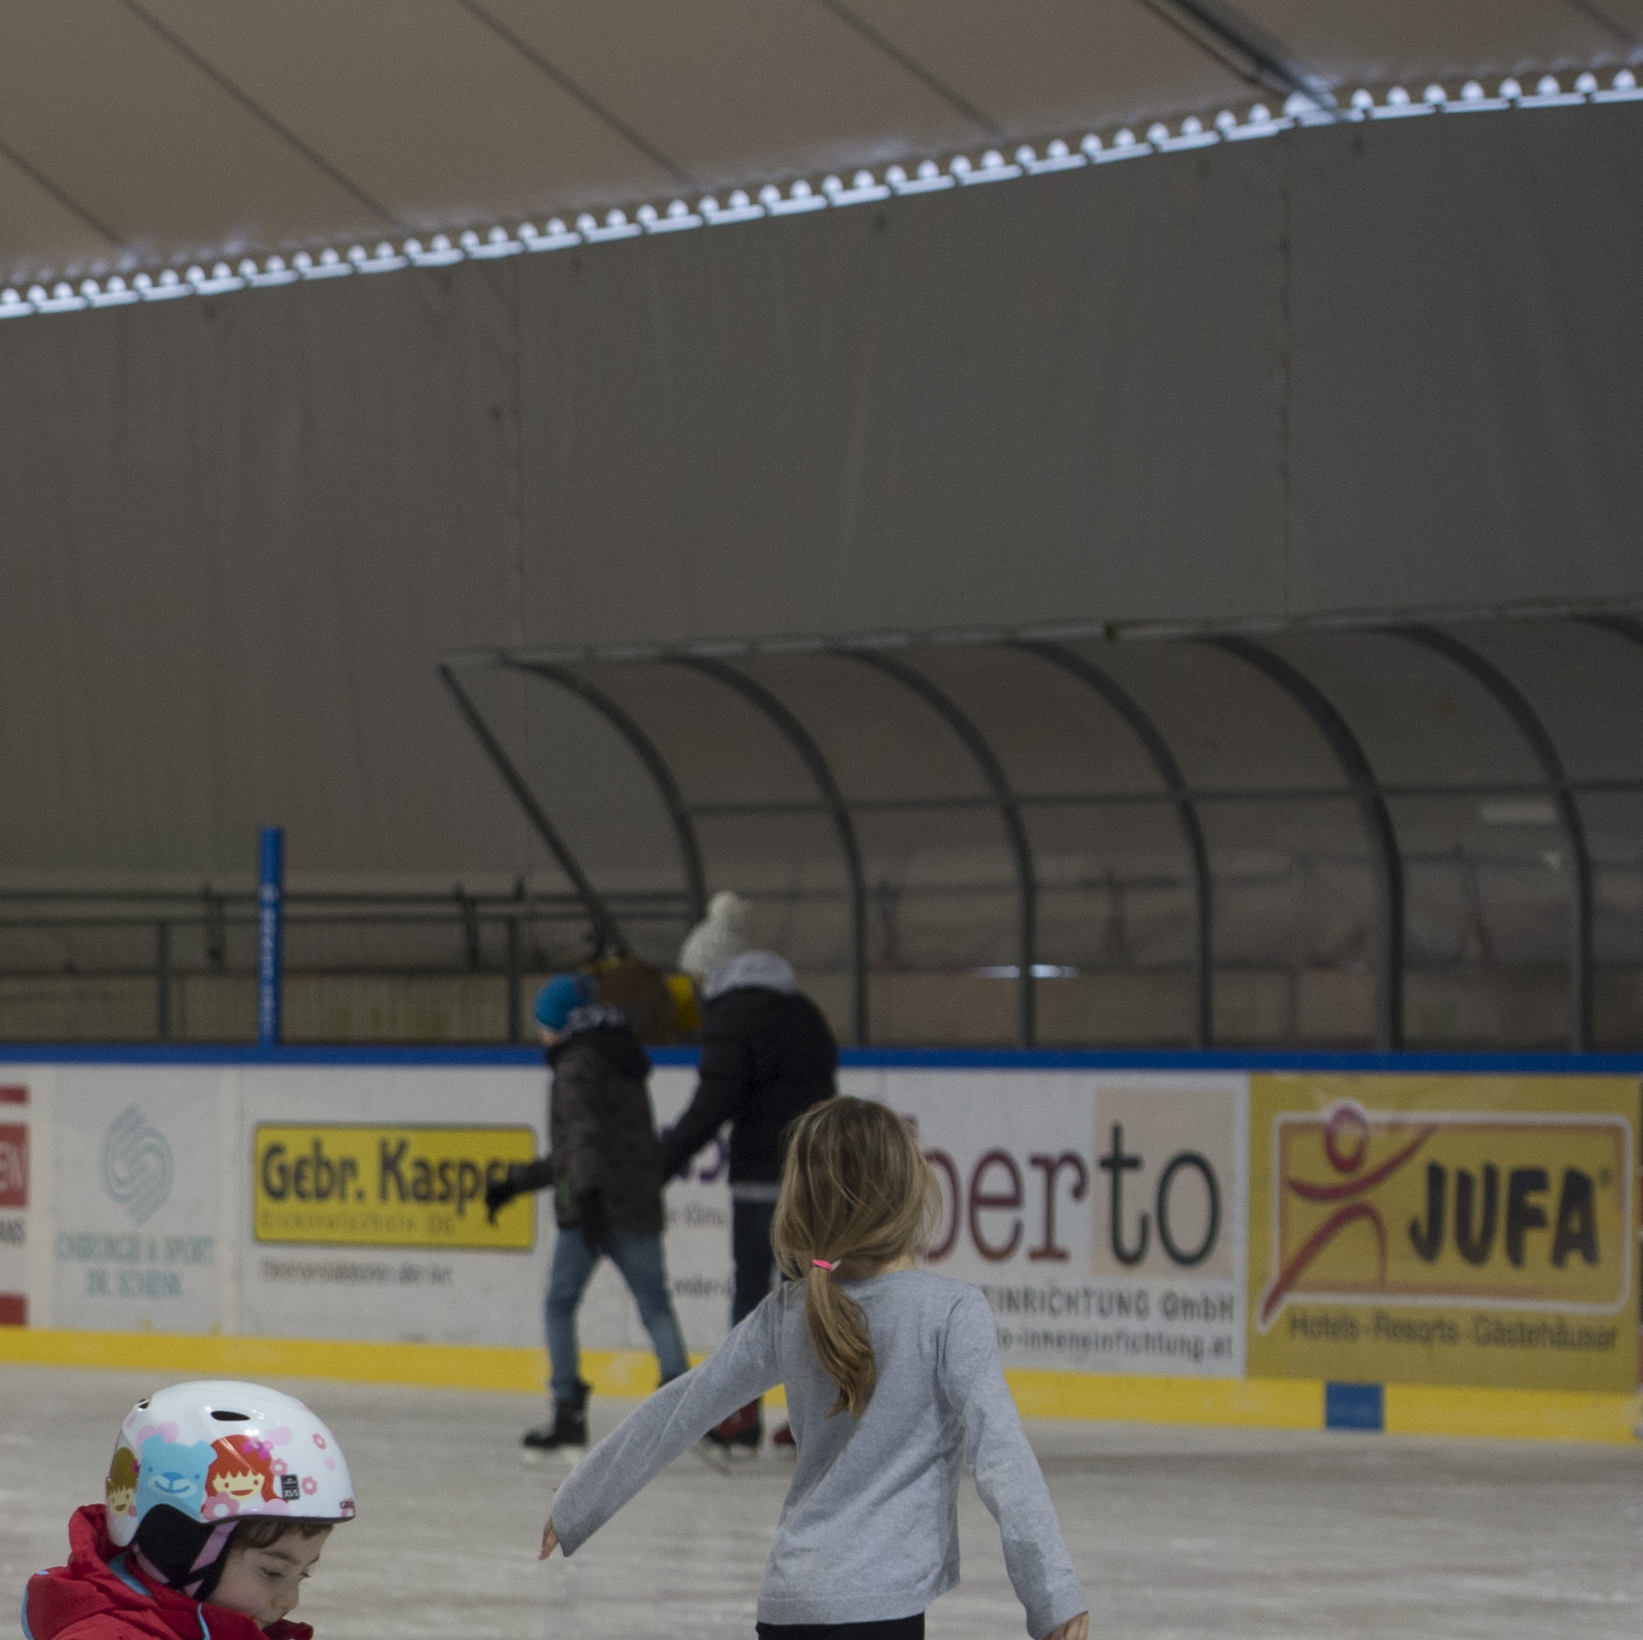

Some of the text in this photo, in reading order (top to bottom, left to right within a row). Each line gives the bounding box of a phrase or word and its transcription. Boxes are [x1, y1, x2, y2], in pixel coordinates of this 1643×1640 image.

[261, 1134, 365, 1202] Gebr.
[1407, 1159, 1600, 1270] JUFA
[1158, 1286, 1235, 1325] GmbH
[1288, 1314, 1360, 1342] Hotels
